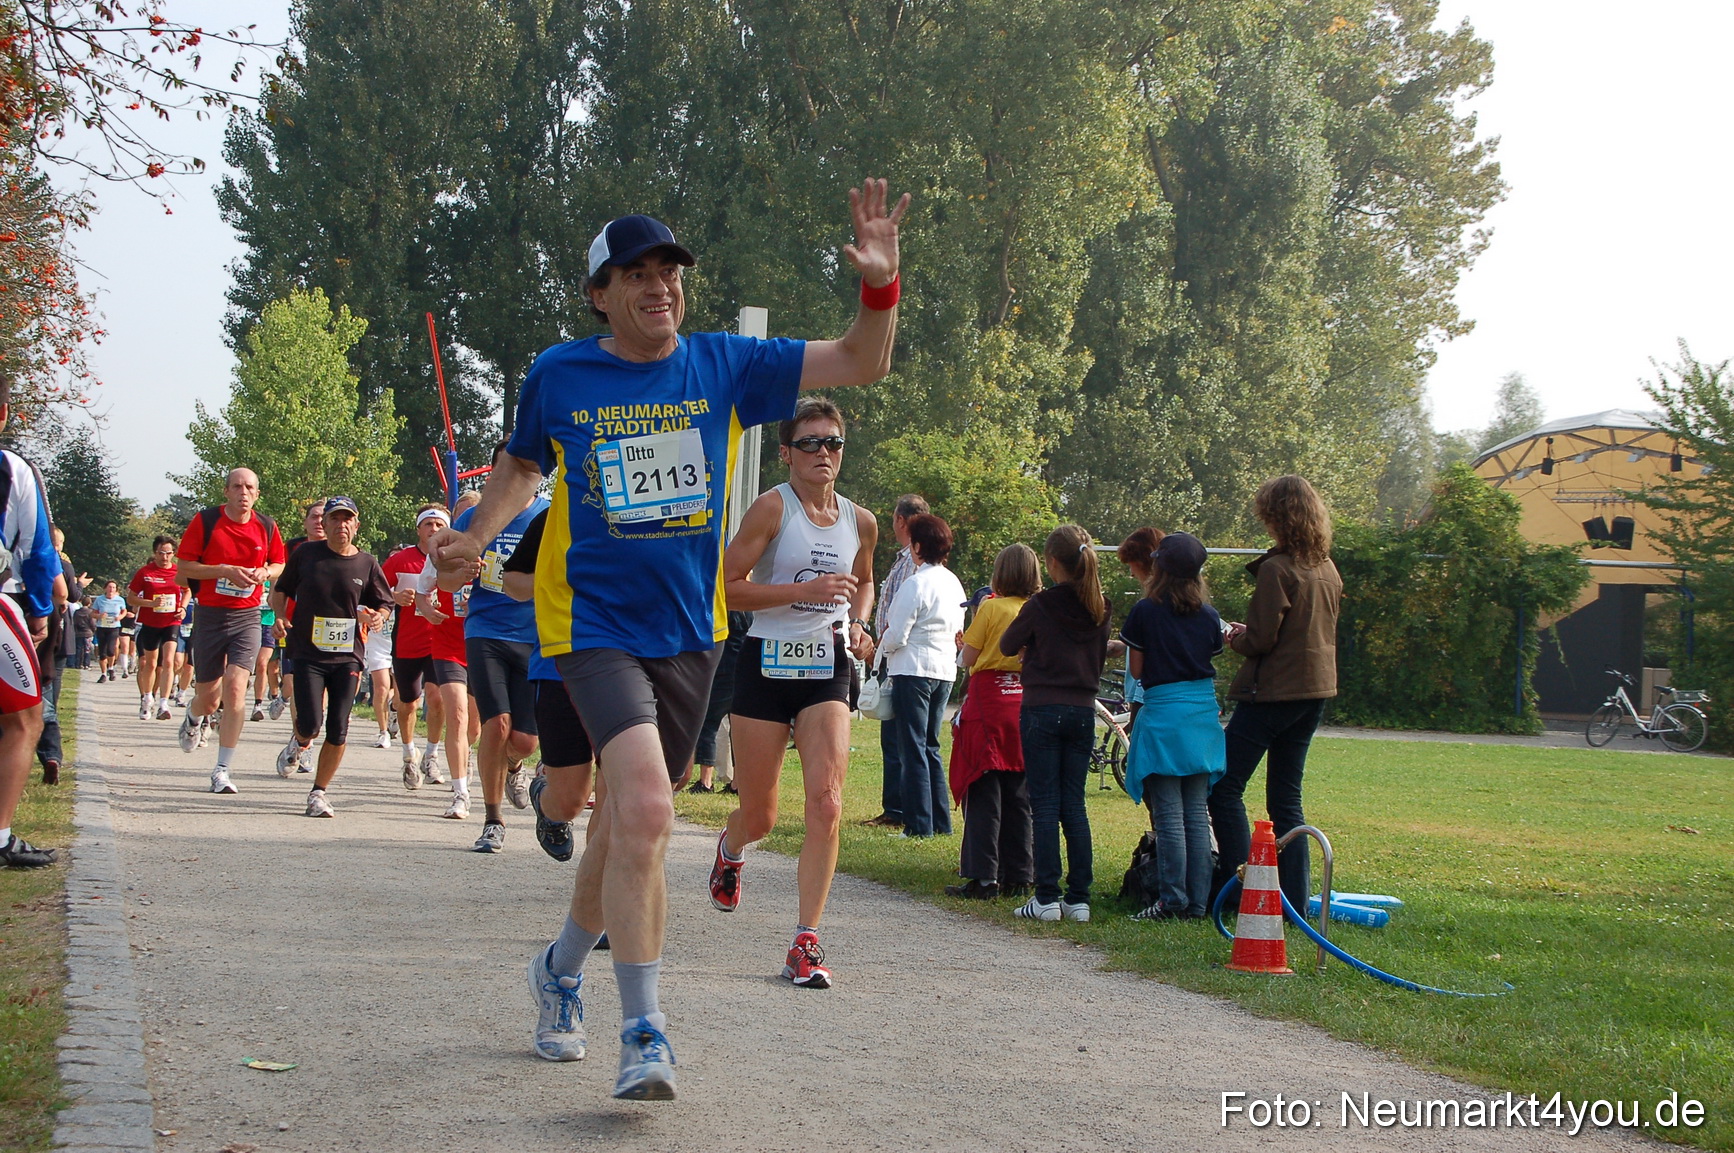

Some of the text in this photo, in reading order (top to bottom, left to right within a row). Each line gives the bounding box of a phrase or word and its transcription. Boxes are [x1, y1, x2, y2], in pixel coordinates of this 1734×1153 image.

[571, 398, 711, 425] 10. NEUMARKTER
[594, 416, 692, 436] STADTLAUF
[626, 445, 655, 462] Otto
[605, 474, 613, 487] C
[632, 463, 698, 495] 2113
[325, 620, 348, 628] Norbert
[328, 631, 348, 641] 513
[782, 642, 827, 659] 2615
